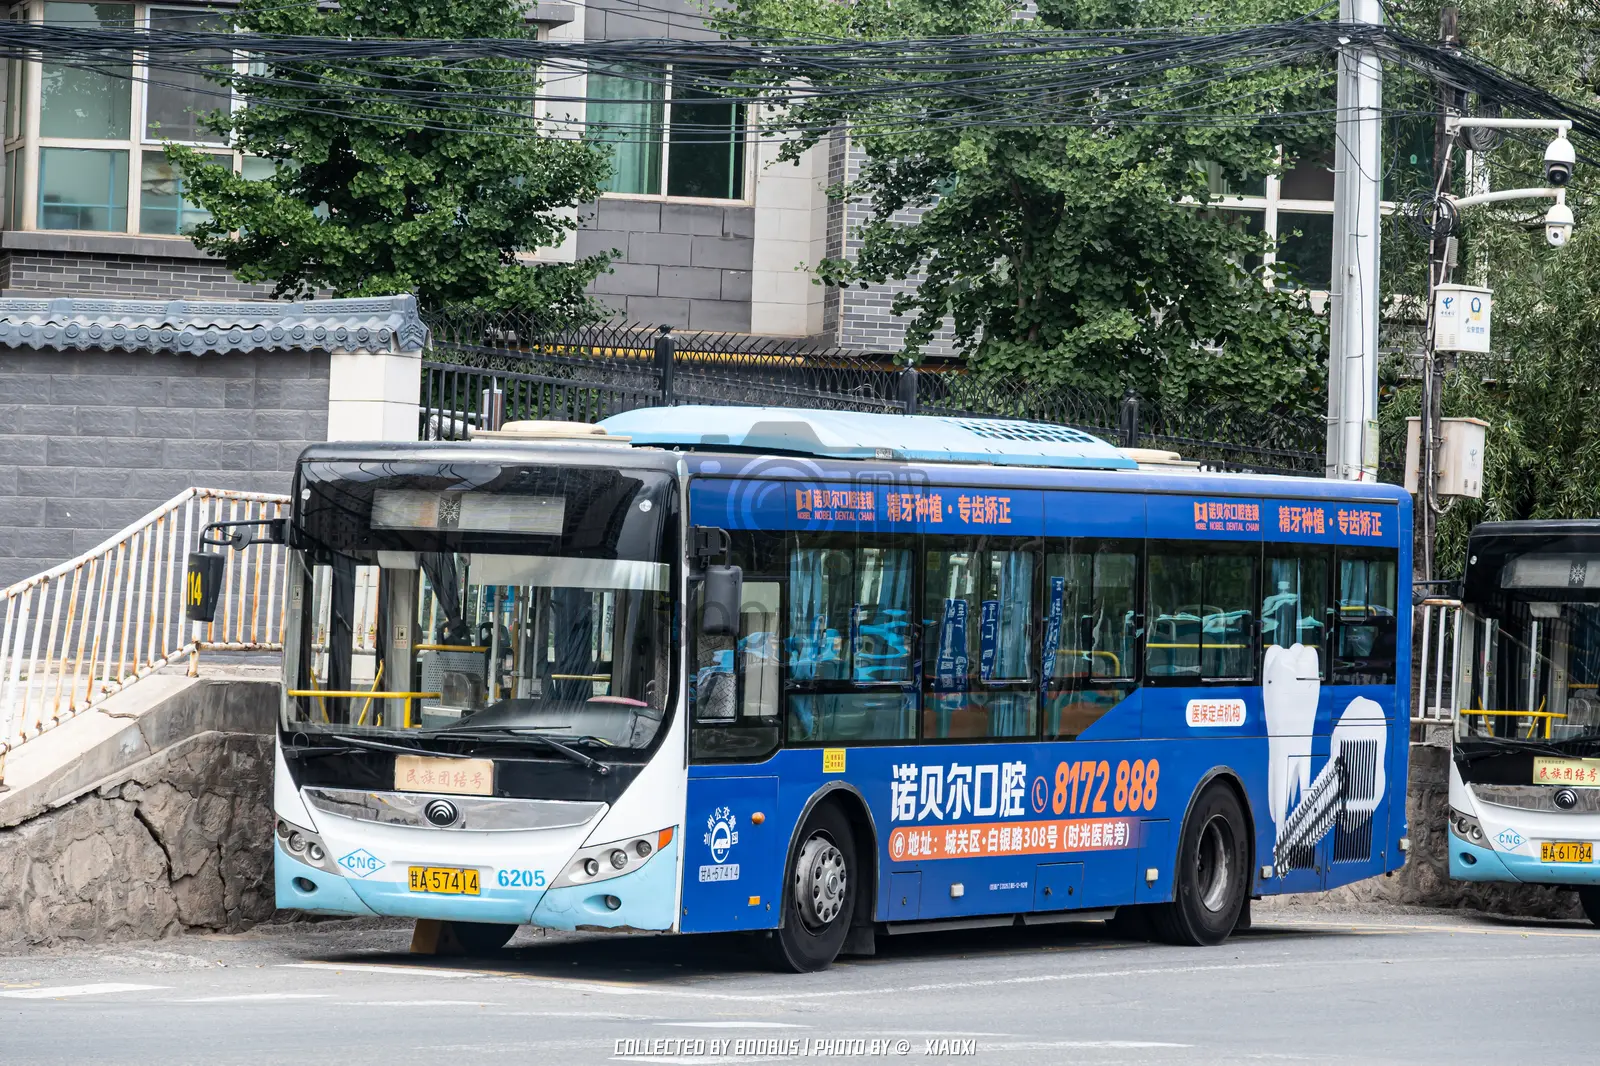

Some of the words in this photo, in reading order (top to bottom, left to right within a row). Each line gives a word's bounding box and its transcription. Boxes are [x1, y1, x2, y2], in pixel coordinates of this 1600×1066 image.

[814, 489, 875, 510] 诺贝尔口腔连锁
[814, 510, 832, 520] NOBEL
[835, 511, 856, 521] DENTAL
[858, 511, 875, 521] CHAIN
[1209, 502, 1259, 521] 诺贝尔口腔连锁
[1209, 521, 1224, 531] NOBEL
[1226, 522, 1244, 531] DENTAL
[1245, 522, 1259, 531] CHAIN
[1192, 704, 1240, 722] 医保定点机构
[406, 768, 485, 789] 民族团结号
[1540, 766, 1598, 782] 民族团结号
[891, 761, 1027, 822] 诺贝尔口腔
[1052, 760, 1110, 815] 8172
[1113, 758, 1160, 812] 888
[1499, 834, 1520, 845] CNG
[347, 855, 376, 870] CNG
[498, 869, 545, 887] 6205
